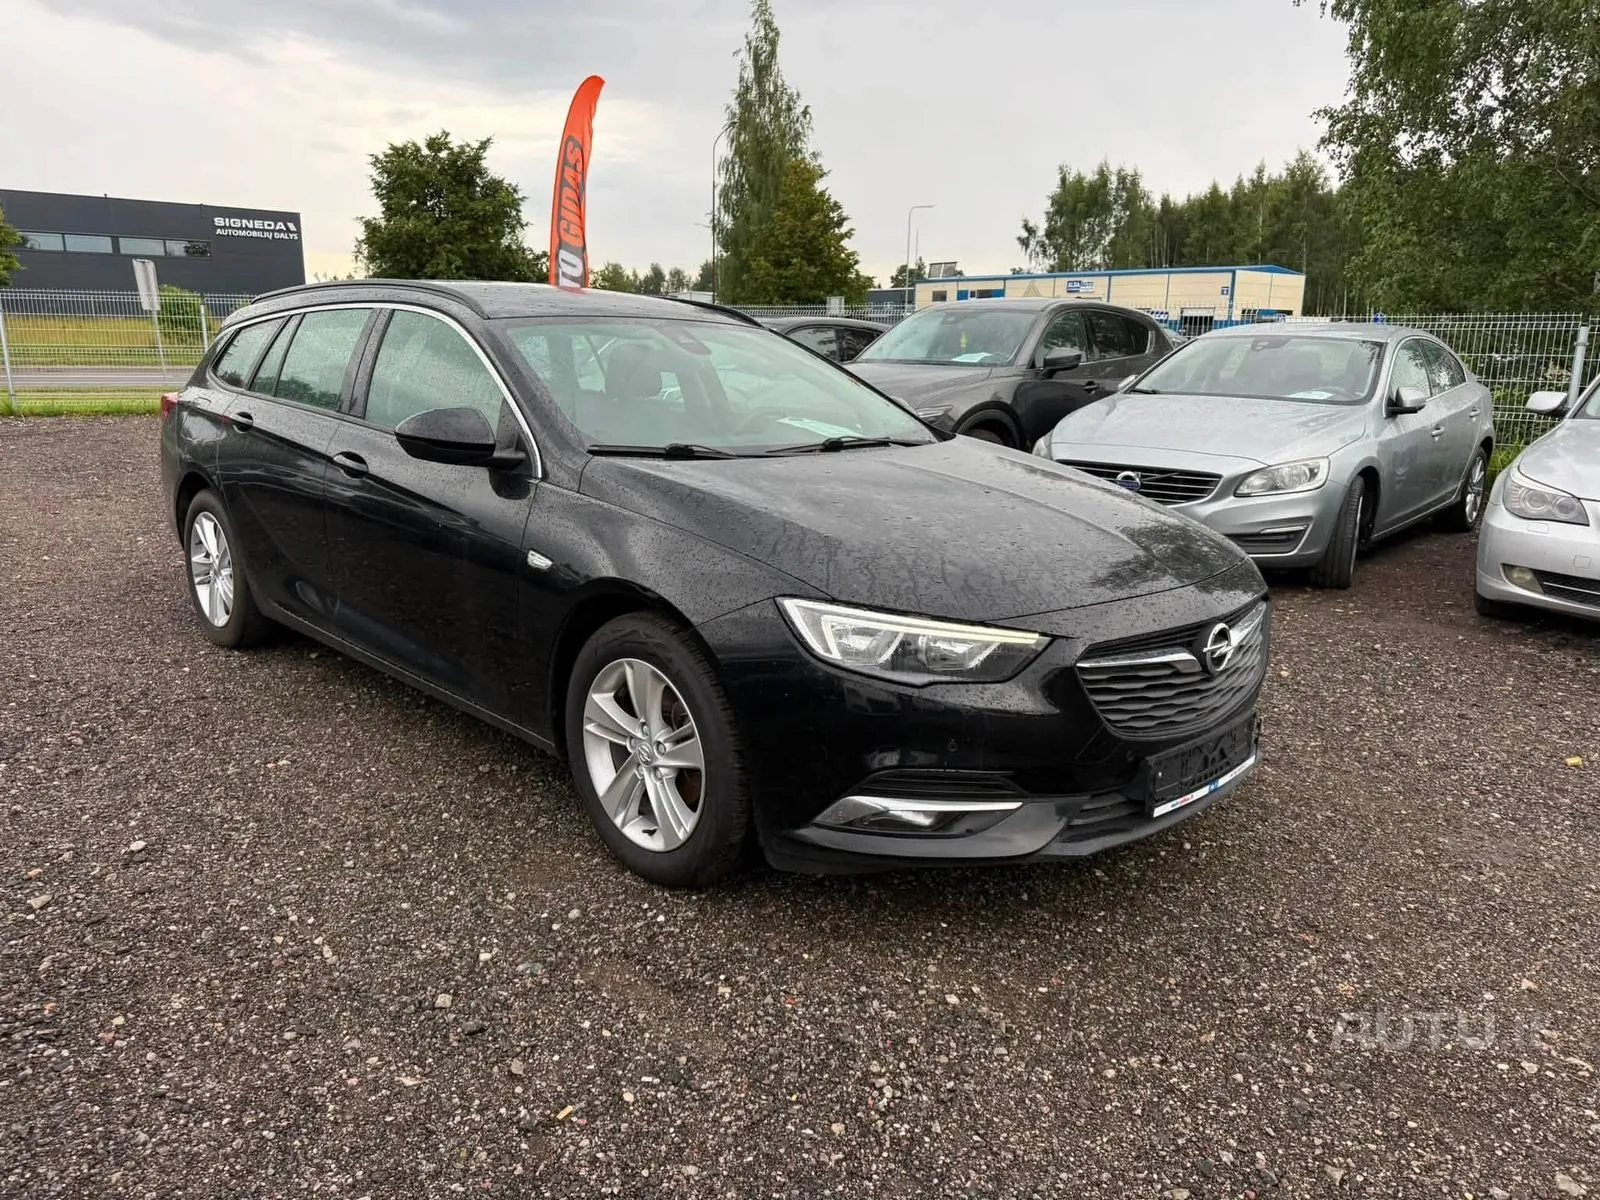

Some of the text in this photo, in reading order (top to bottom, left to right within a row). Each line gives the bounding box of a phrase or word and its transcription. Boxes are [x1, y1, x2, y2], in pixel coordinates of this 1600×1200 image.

[213, 217, 287, 231] SIGNEDA
[216, 228, 299, 240] AUTOMOBILIŲ DALYS
